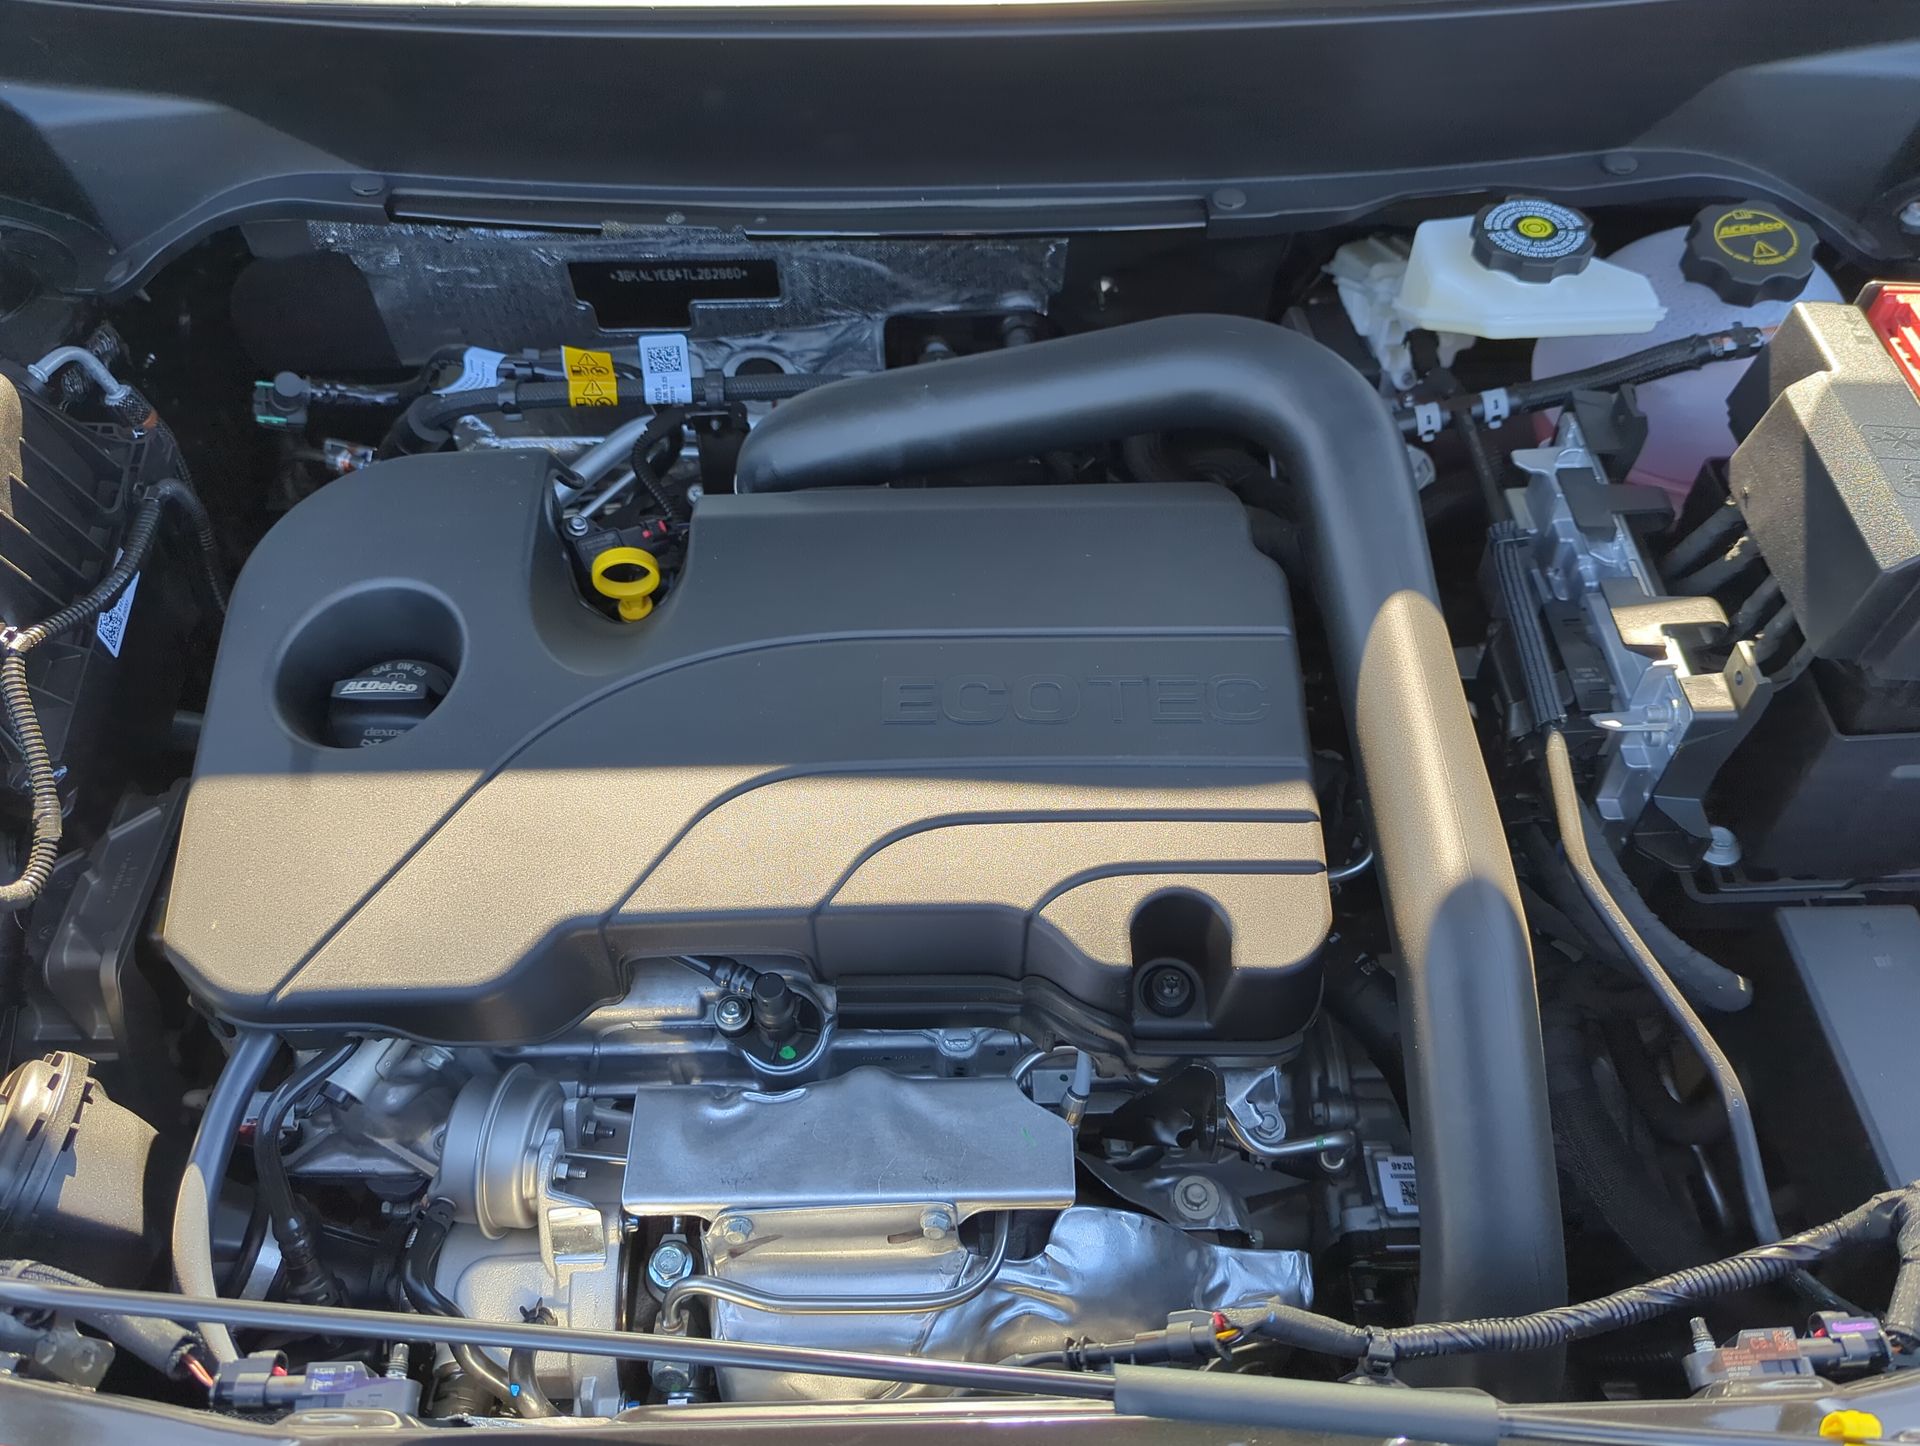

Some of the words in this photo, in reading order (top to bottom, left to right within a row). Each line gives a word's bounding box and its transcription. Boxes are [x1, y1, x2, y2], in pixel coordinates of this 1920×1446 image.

[1720, 222, 1785, 236] ACDelco
[372, 663, 392, 676] SAE
[396, 662, 427, 677] 0W-20
[341, 680, 418, 693] ACDelco
[881, 673, 1271, 726] ECOTEC
